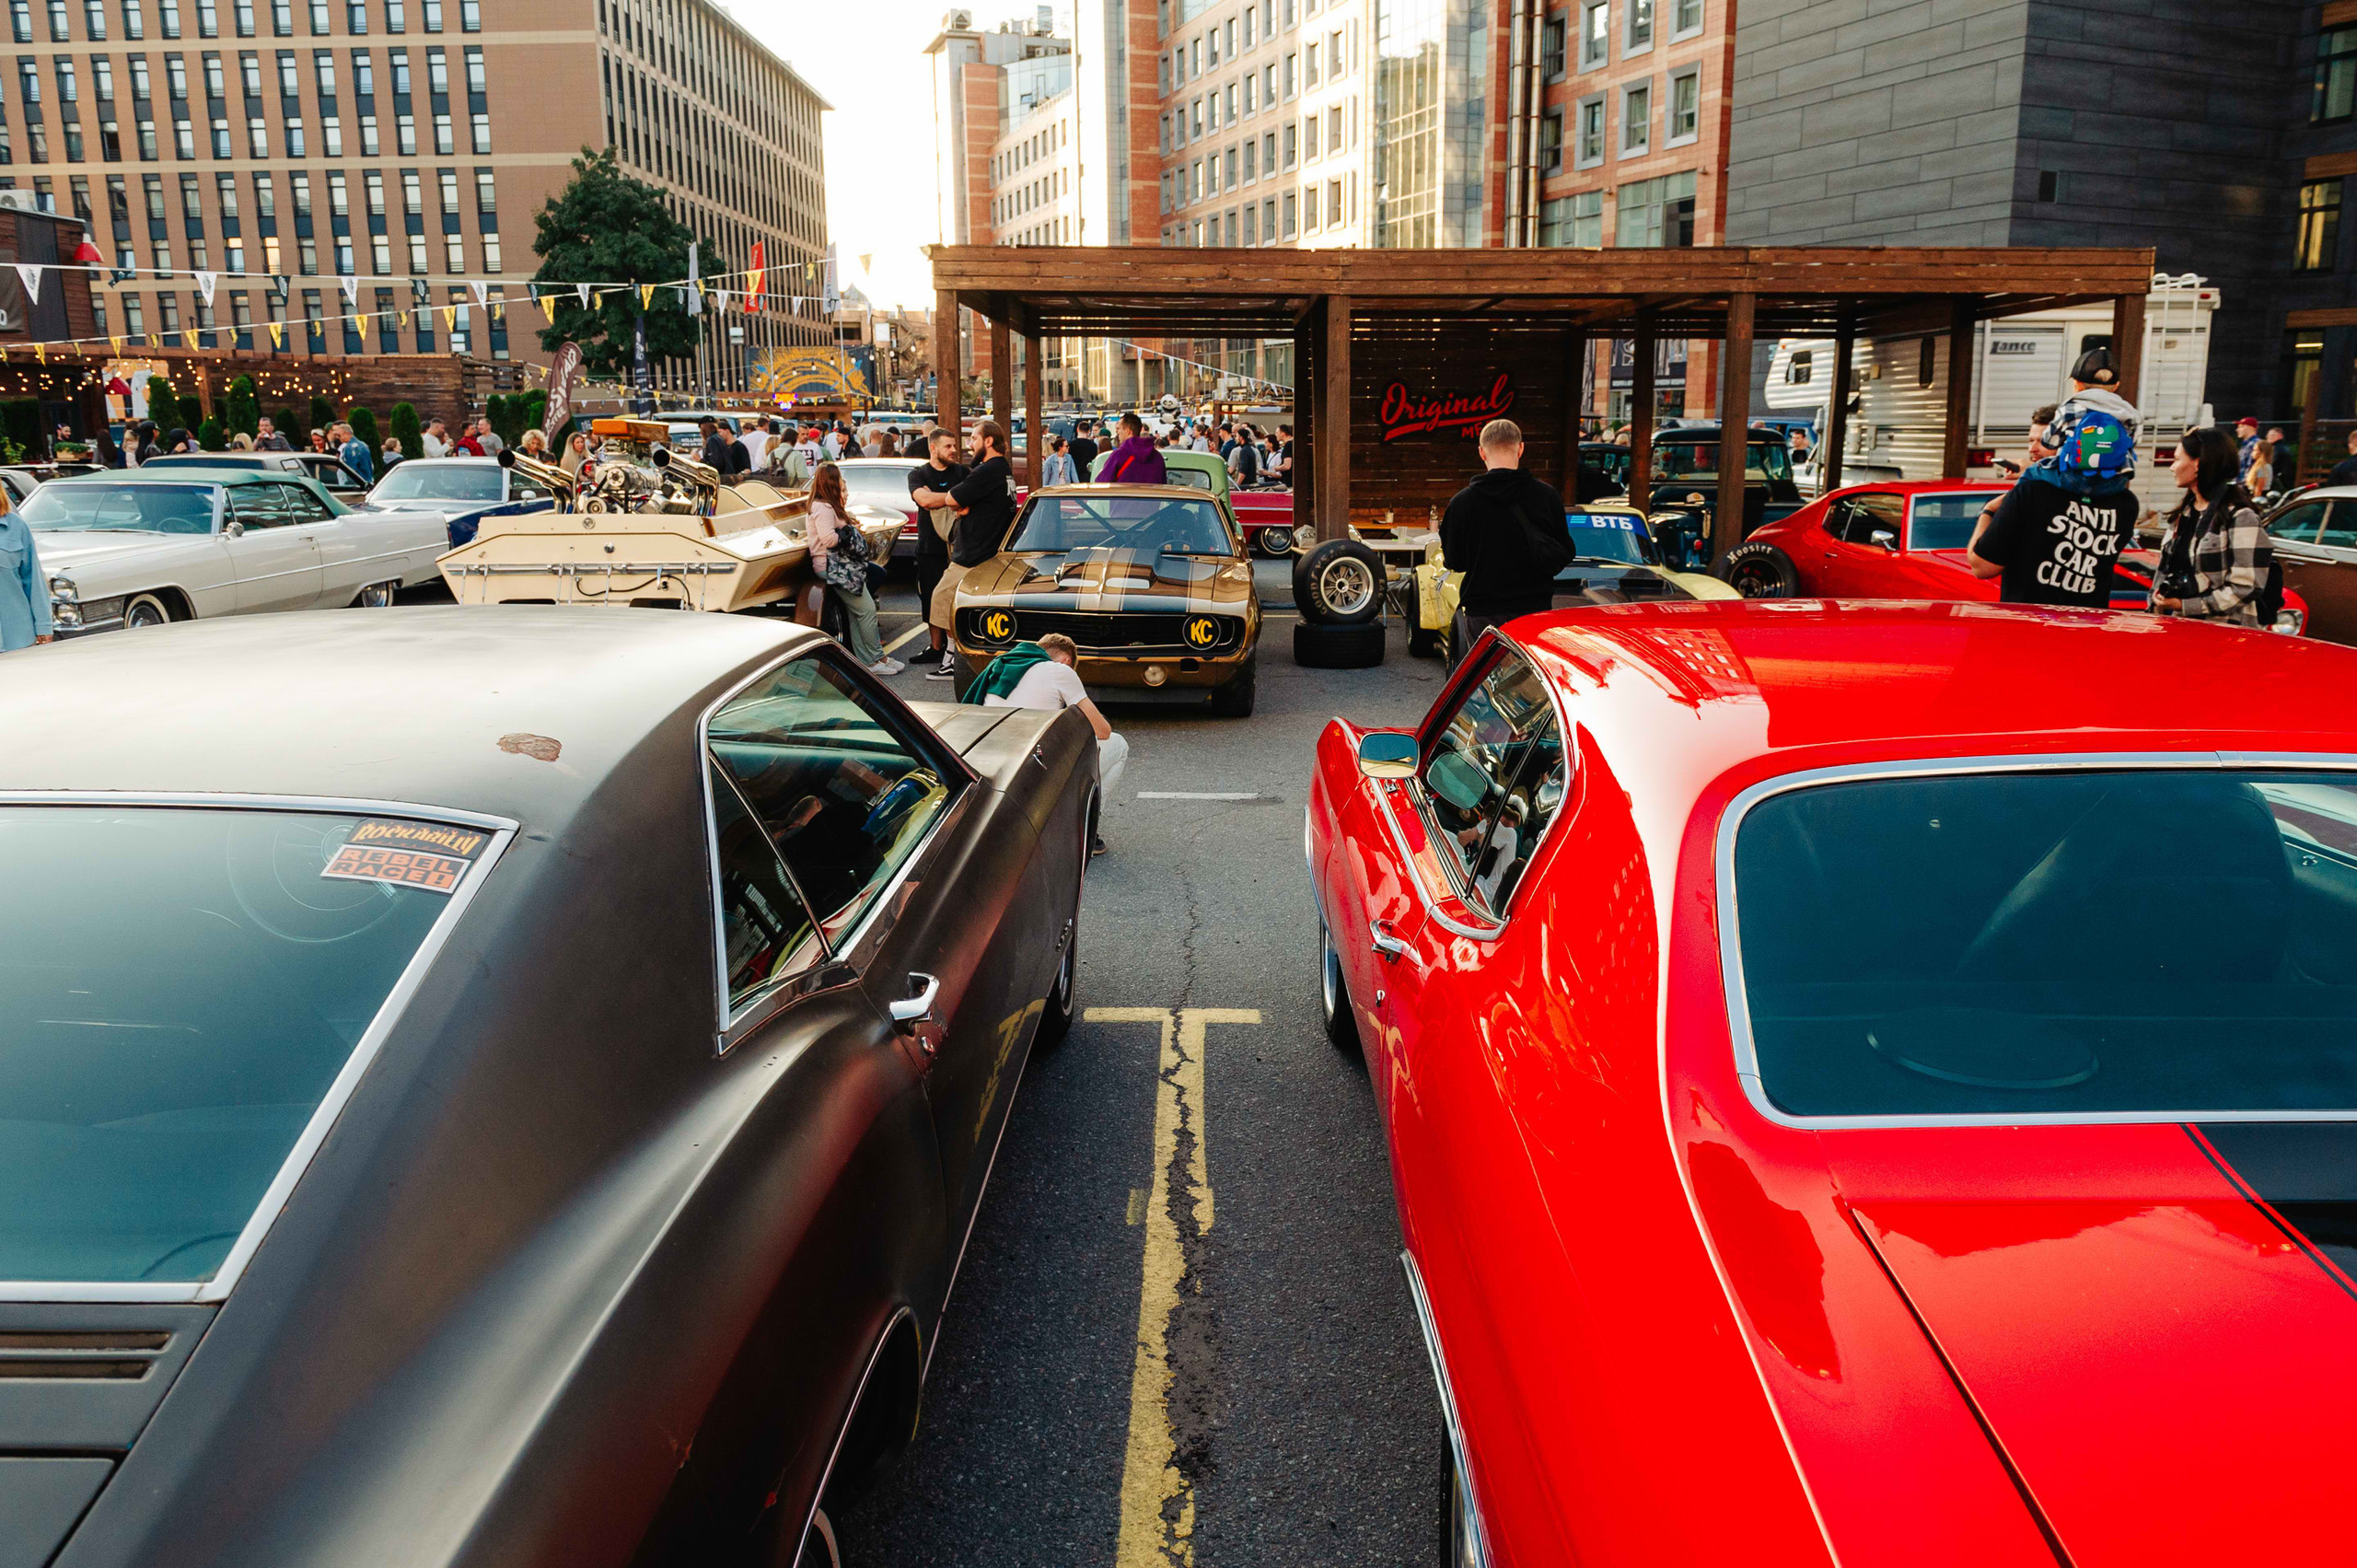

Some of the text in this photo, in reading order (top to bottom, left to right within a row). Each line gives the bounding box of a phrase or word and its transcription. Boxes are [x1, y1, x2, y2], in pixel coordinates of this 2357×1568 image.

[1990, 341, 2036, 354] Lance
[1381, 373, 1514, 432] Original
[1461, 420, 1490, 438] MF
[1591, 515, 1633, 530] ВТБ
[2066, 500, 2117, 531] ANTI
[2047, 516, 2120, 555] STOCK
[1726, 543, 1772, 564] Hoosier
[2054, 541, 2098, 576] CAR
[2037, 561, 2096, 593] CLUB
[987, 612, 1009, 638] KC
[1190, 619, 1213, 644] KC
[331, 862, 444, 884] RACE!
[341, 849, 453, 873] REBEL
